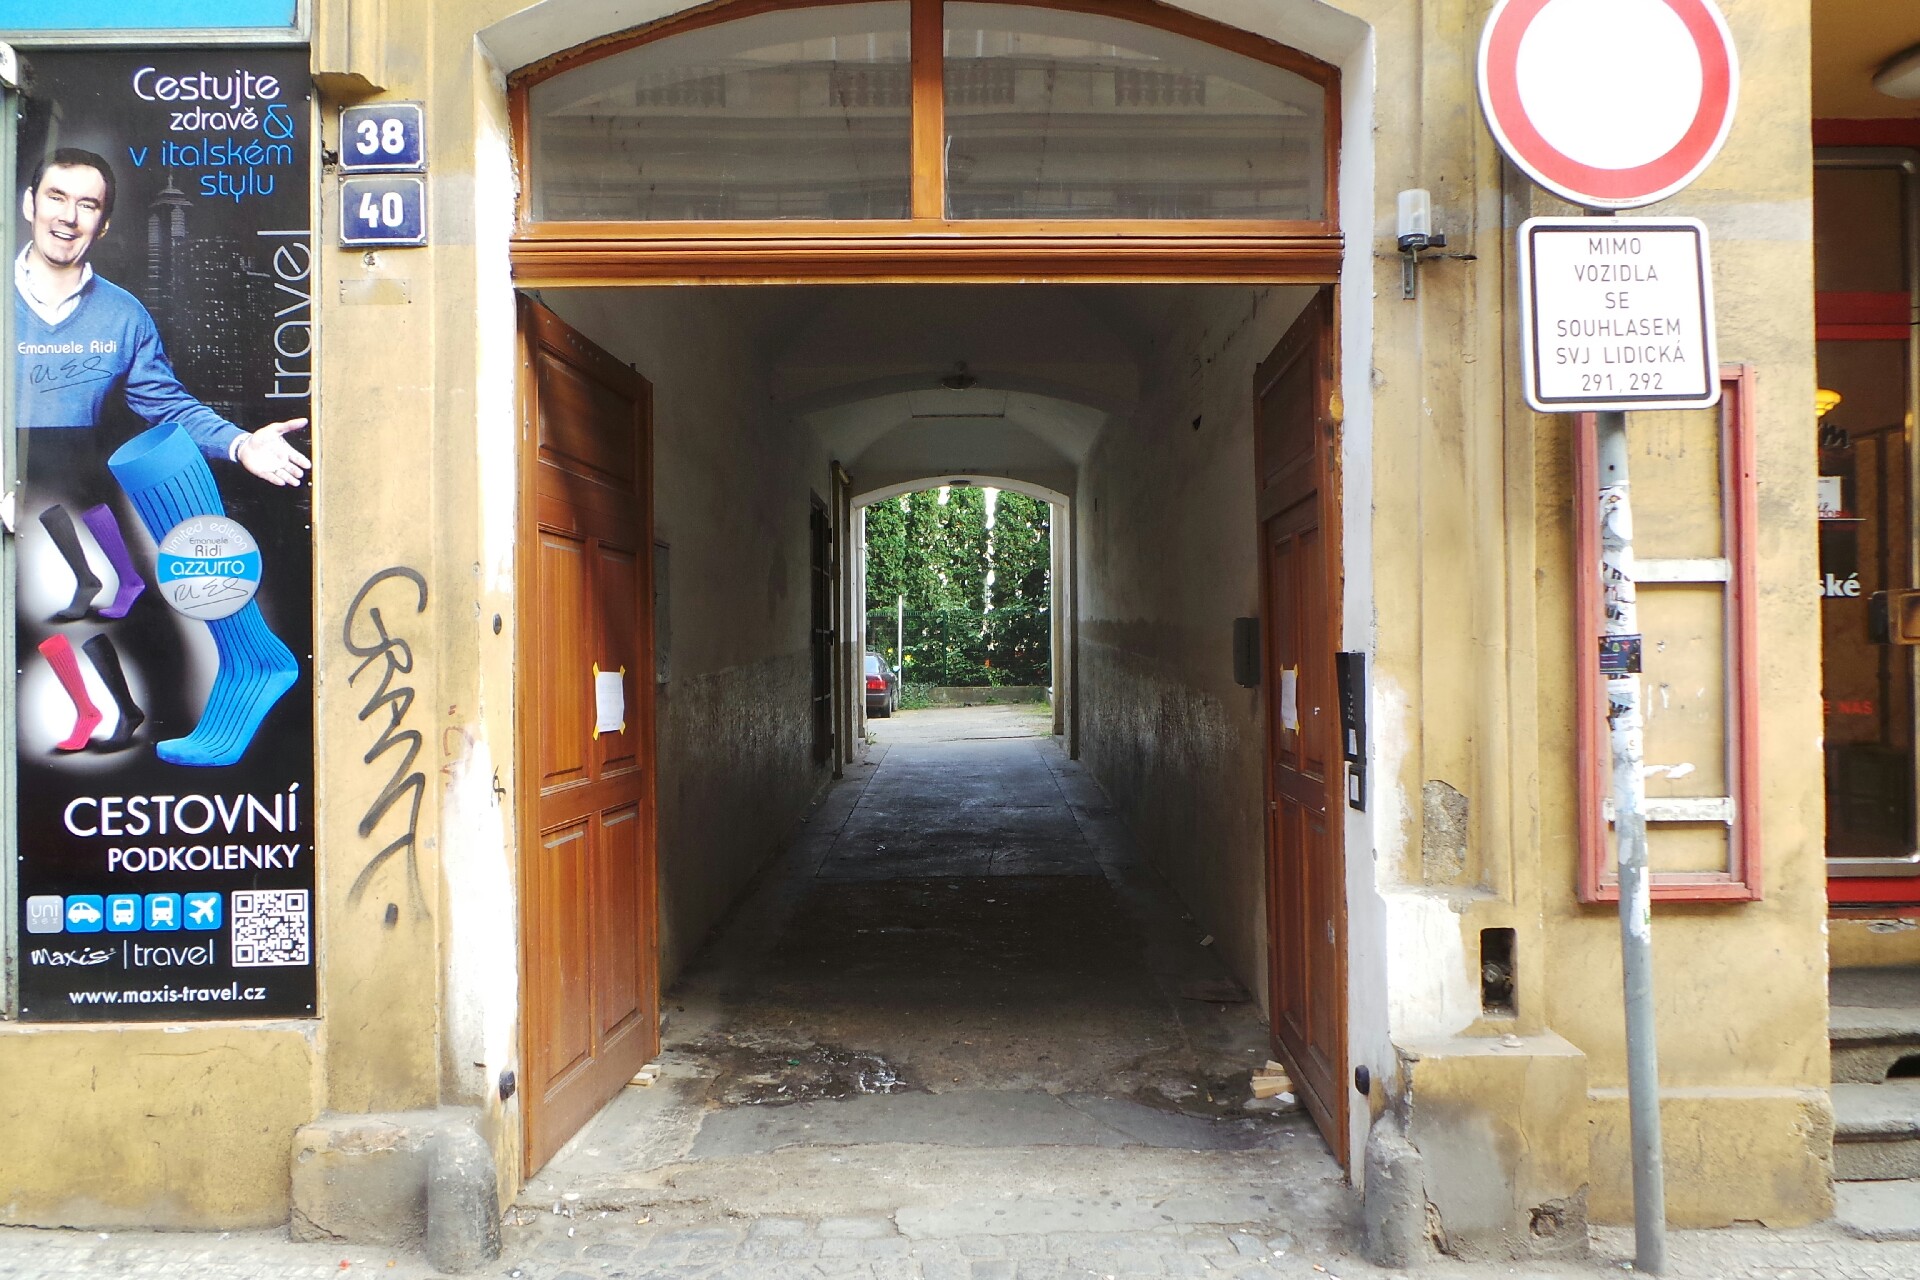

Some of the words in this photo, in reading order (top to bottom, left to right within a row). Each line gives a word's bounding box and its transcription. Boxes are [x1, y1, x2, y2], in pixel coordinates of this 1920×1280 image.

[133, 67, 280, 109] Cestujte
[170, 106, 259, 132] zdravě
[262, 104, 294, 140] &
[357, 118, 405, 155] 38
[129, 146, 149, 167] v
[161, 138, 293, 166] italském
[200, 167, 275, 204] stylu
[358, 191, 404, 229] 40
[1588, 237, 1642, 255] MIMO
[1574, 264, 1659, 282] VOZIDLA
[1605, 291, 1630, 309] SE
[257, 230, 312, 398] travel
[1556, 318, 1681, 338] SOUHLASEM
[17, 341, 84, 355] Emanuele
[90, 340, 117, 354] Ridi
[1556, 347, 1590, 365] SVJ
[1603, 339, 1686, 364] LIDICKÁ
[163, 520, 204, 554] limited
[209, 521, 248, 551] edition
[189, 537, 229, 545] Emanuele
[194, 544, 222, 557] Ridi
[170, 560, 246, 576] azzurro
[63, 782, 300, 837] CESTOVNÍ
[108, 844, 301, 872] PODKOLENKY
[31, 900, 59, 918] uni
[134, 938, 214, 967] travel
[69, 982, 266, 1005] www.maxis-travel.cz
